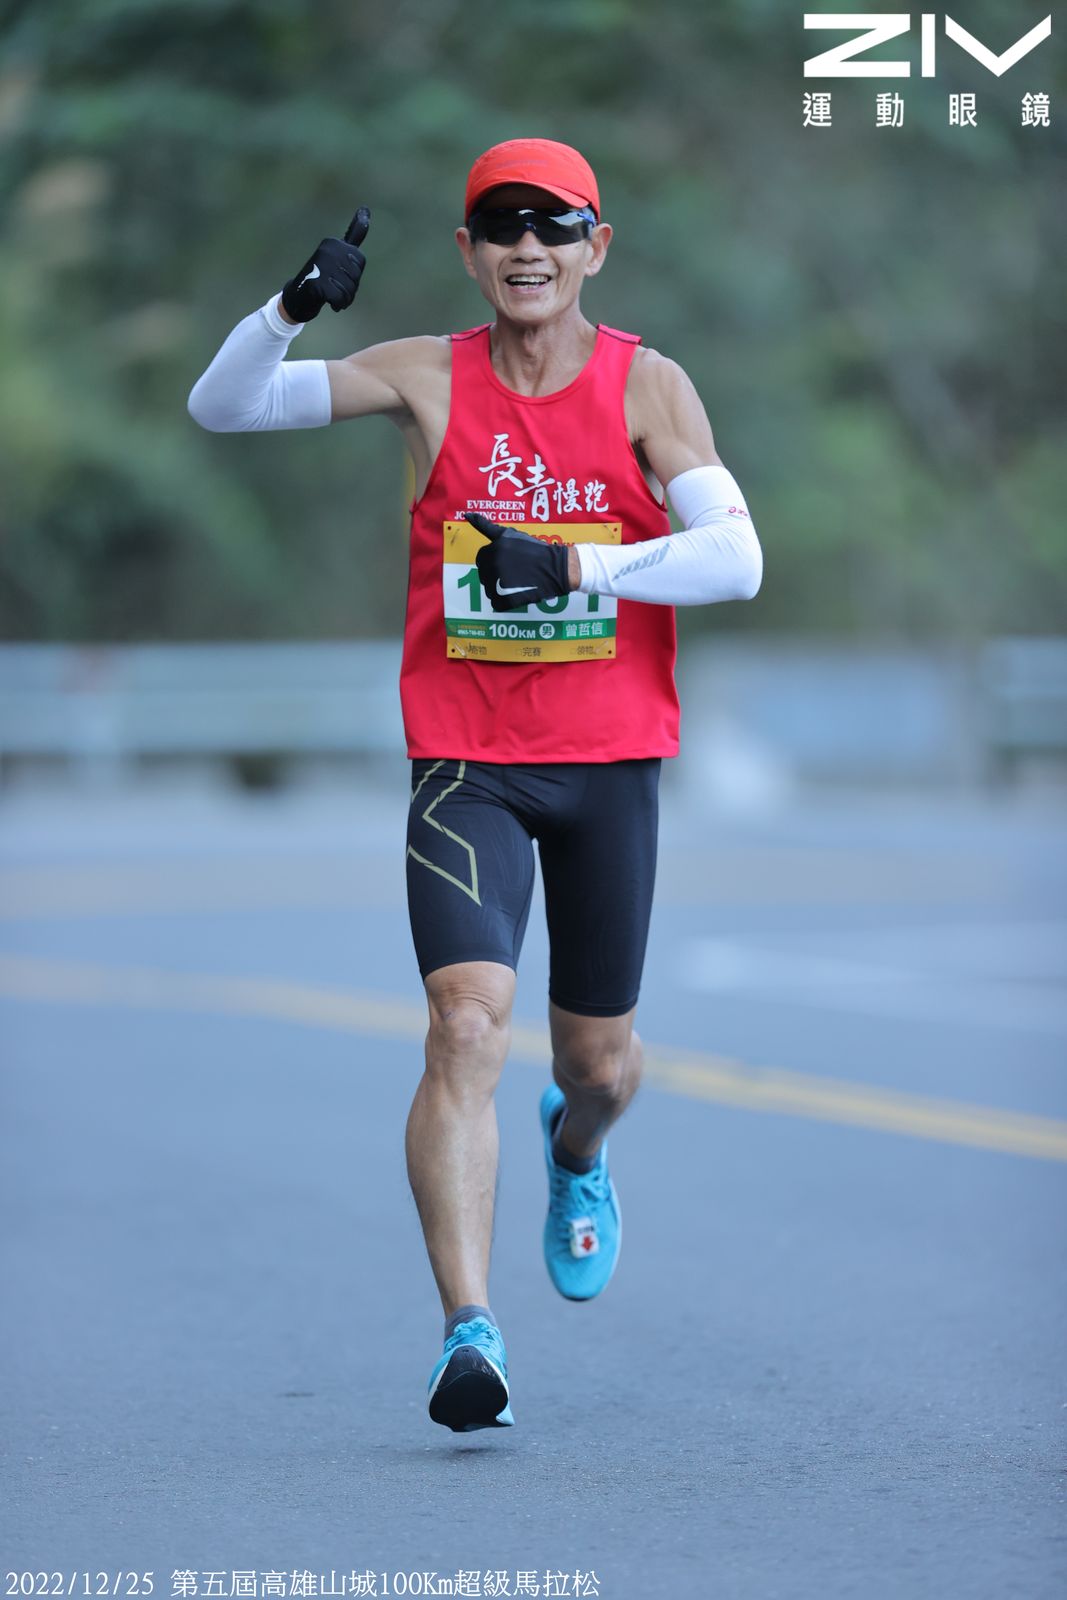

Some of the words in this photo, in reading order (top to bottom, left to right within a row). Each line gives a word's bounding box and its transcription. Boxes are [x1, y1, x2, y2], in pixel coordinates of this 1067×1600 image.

[478, 433, 609, 522] 長青慢跑
[466, 500, 526, 510] EVERGREEN
[498, 511, 526, 521] CLUB
[489, 623, 536, 639] 100KM
[540, 624, 554, 638] 男
[565, 622, 604, 637] 曾哲信
